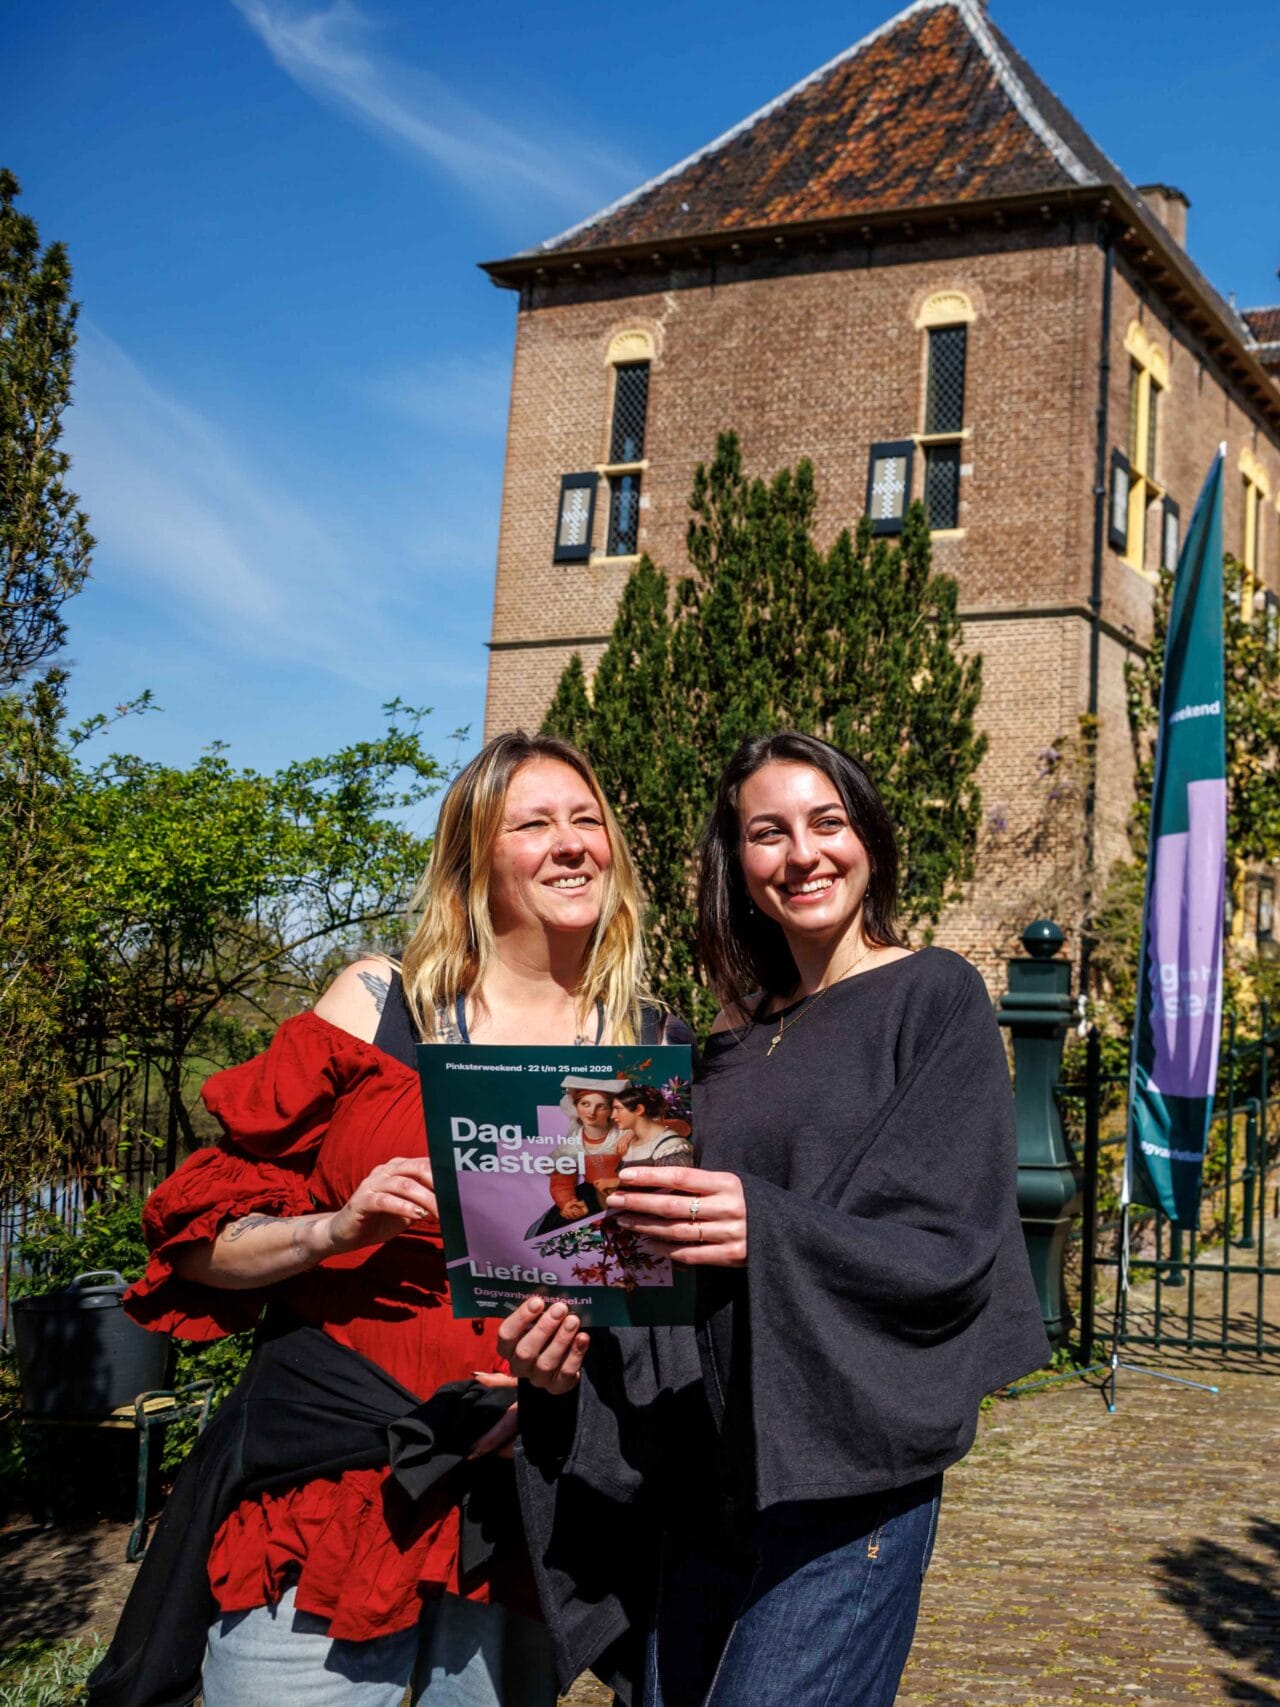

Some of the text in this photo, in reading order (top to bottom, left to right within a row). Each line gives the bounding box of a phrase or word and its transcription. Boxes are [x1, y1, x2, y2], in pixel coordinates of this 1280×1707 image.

[446, 1063, 522, 1072] Pinksterweekend
[450, 1117, 581, 1150] Dag van het
[453, 1147, 585, 1174] Kasteel
[470, 1260, 558, 1285] Liefde
